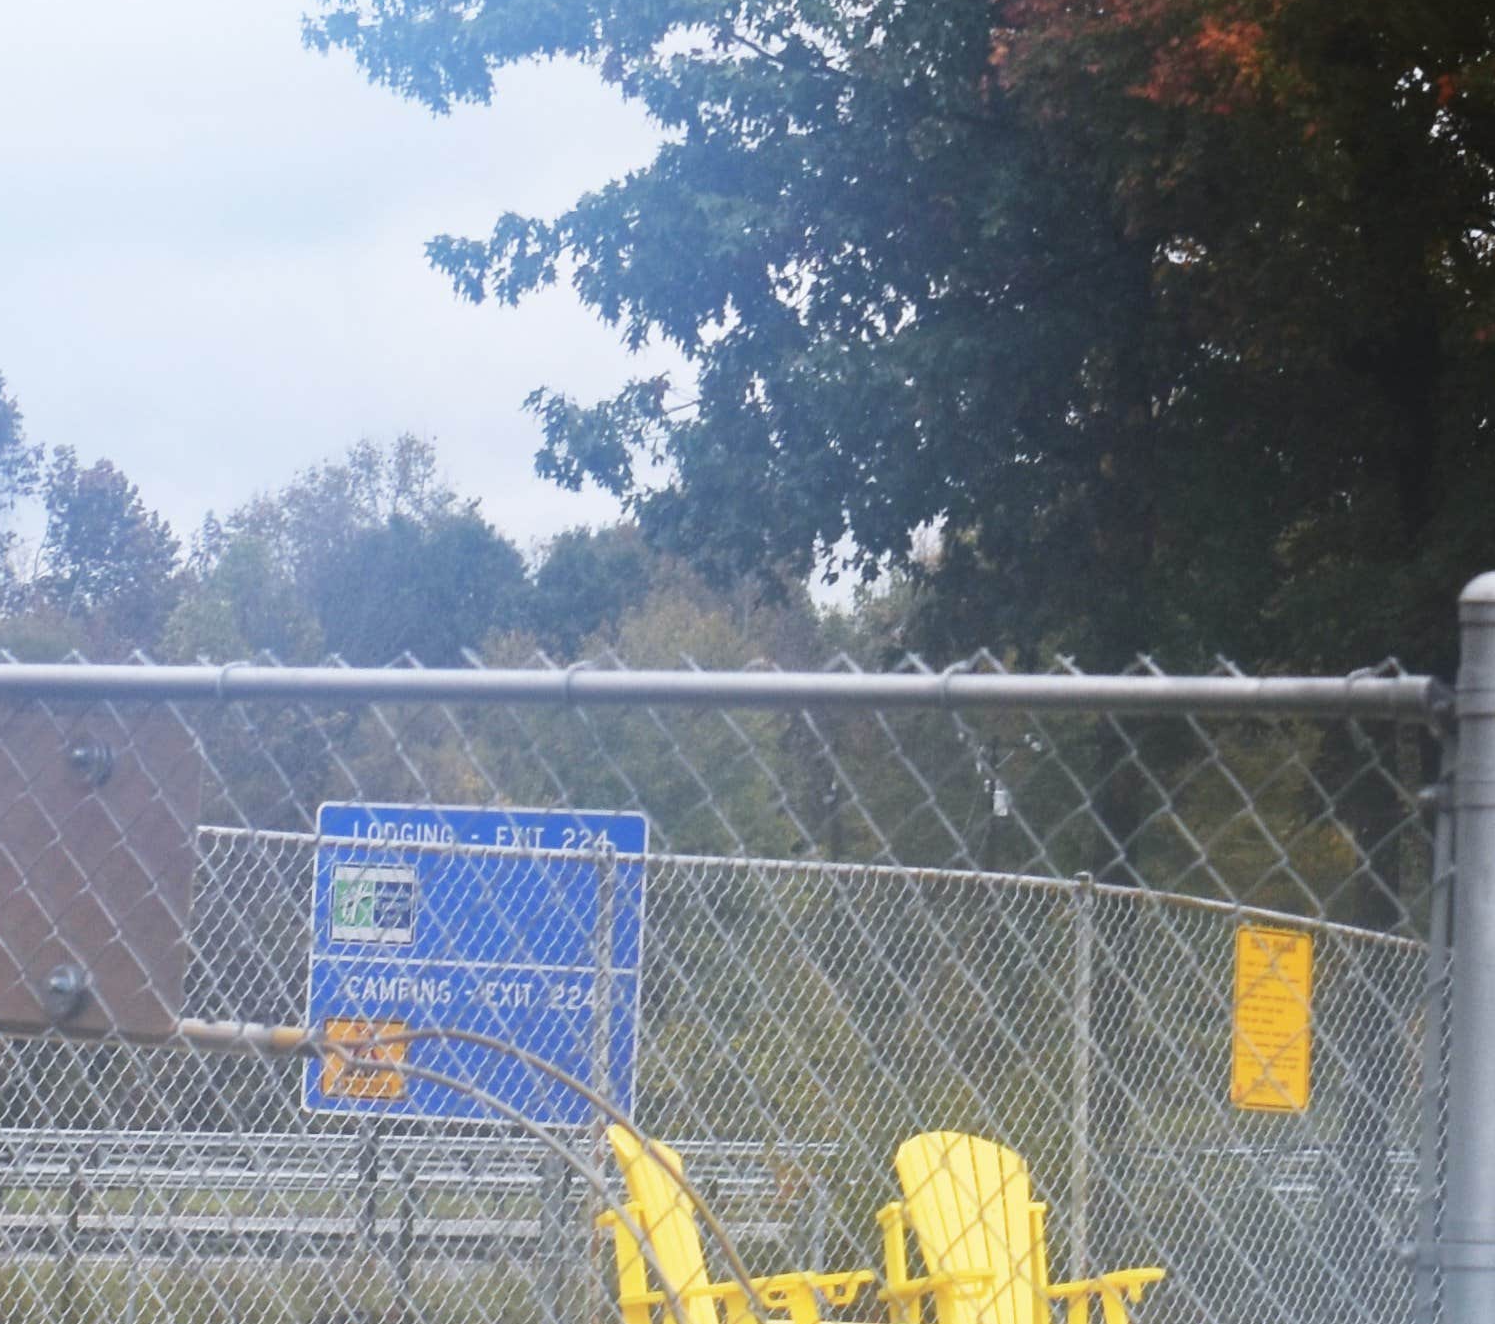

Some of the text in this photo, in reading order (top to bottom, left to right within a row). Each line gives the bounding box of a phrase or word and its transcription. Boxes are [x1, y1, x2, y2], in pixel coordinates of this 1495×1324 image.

[353, 821, 454, 844] LODGING
[495, 826, 545, 849] EXIT
[345, 976, 452, 1004] CAMPING
[485, 981, 533, 1008] EXIT
